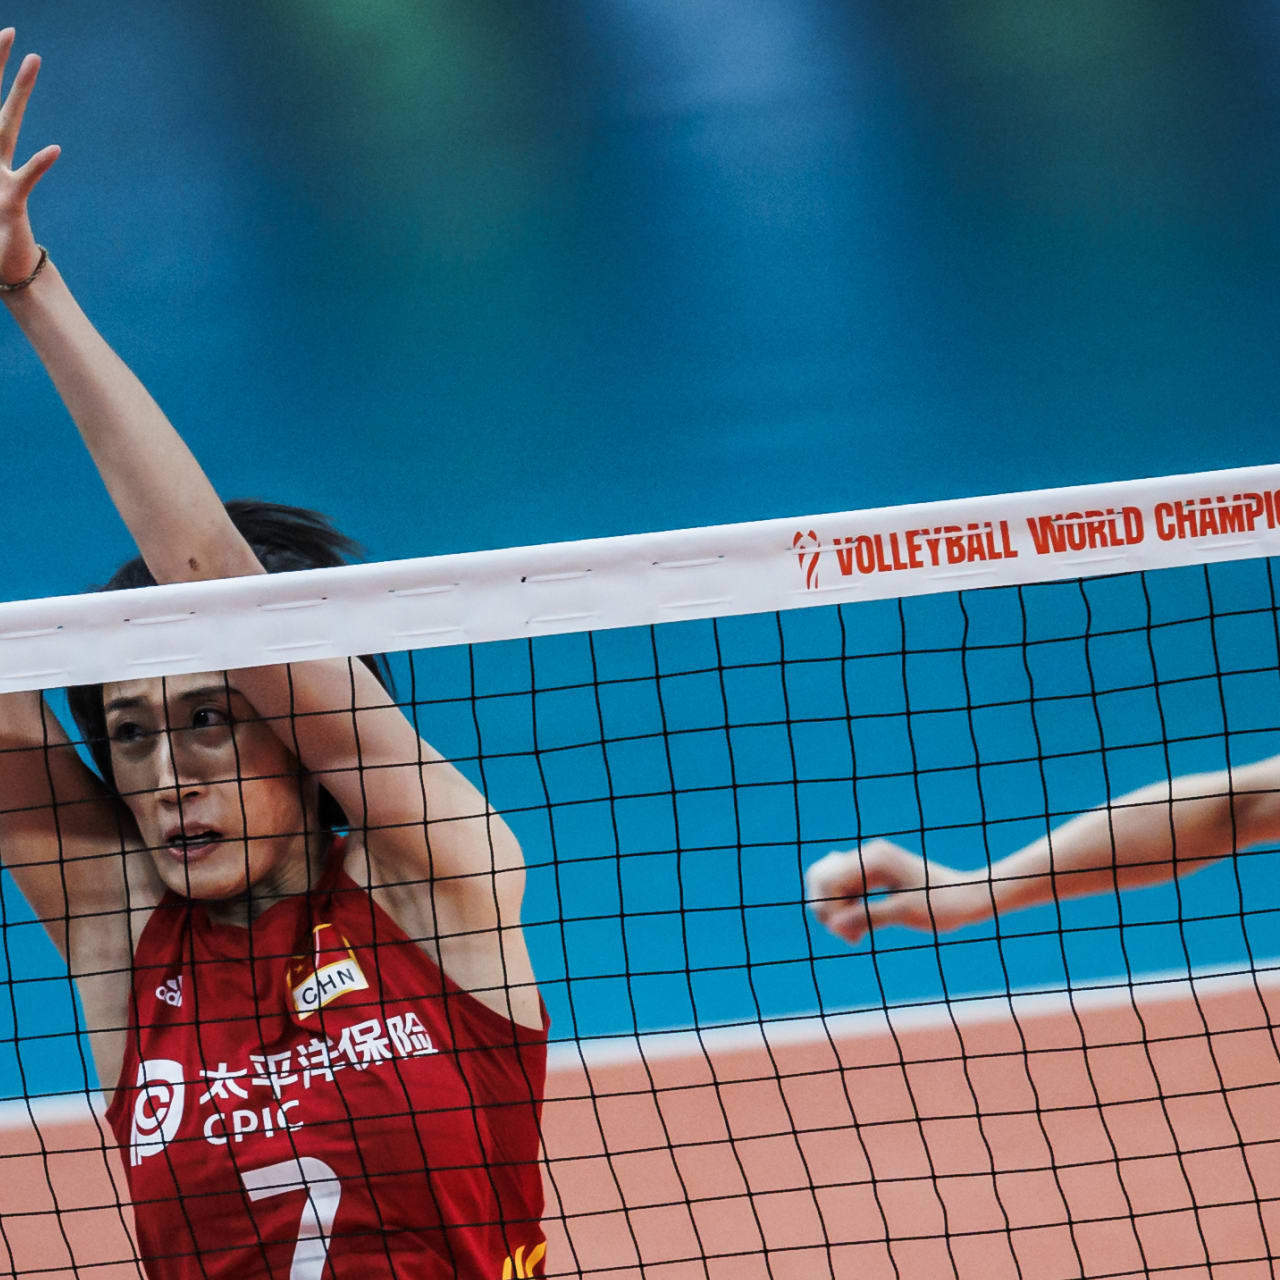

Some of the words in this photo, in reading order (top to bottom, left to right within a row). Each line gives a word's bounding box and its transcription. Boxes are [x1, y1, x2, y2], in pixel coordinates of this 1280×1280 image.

[832, 520, 1018, 577] VOLLEYBALL
[1027, 506, 1144, 555] WORLD
[1154, 489, 1280, 542] CHAMPI
[302, 967, 354, 1005] CHN
[198, 1012, 439, 1105] 太平洋保险
[203, 1100, 304, 1146] CPIC
